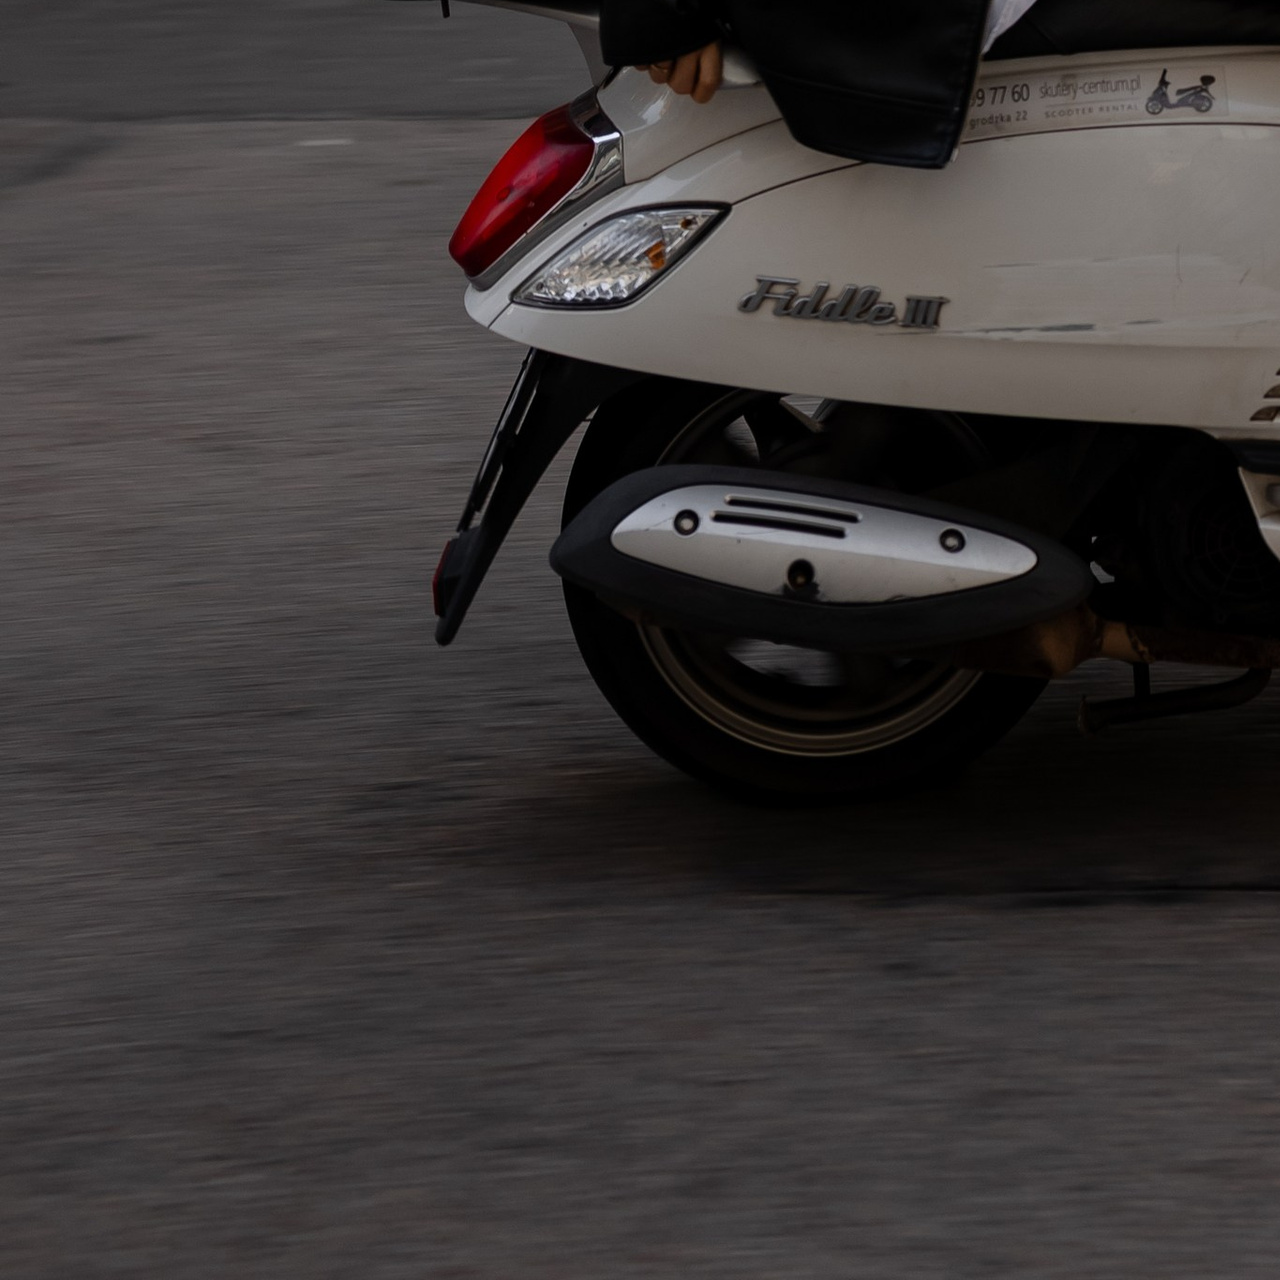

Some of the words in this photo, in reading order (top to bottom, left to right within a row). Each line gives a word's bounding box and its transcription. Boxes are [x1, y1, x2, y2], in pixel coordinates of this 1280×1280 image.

[989, 86, 1007, 105] 77
[1011, 83, 1030, 103] 60
[1039, 75, 1141, 101] skutery-centrum.pl
[1015, 110, 1028, 122] 22
[1045, 106, 1093, 118] SCOOTER
[1099, 104, 1137, 112] RENTAL
[738, 275, 896, 324] Fiddle
[898, 296, 950, 328] III
